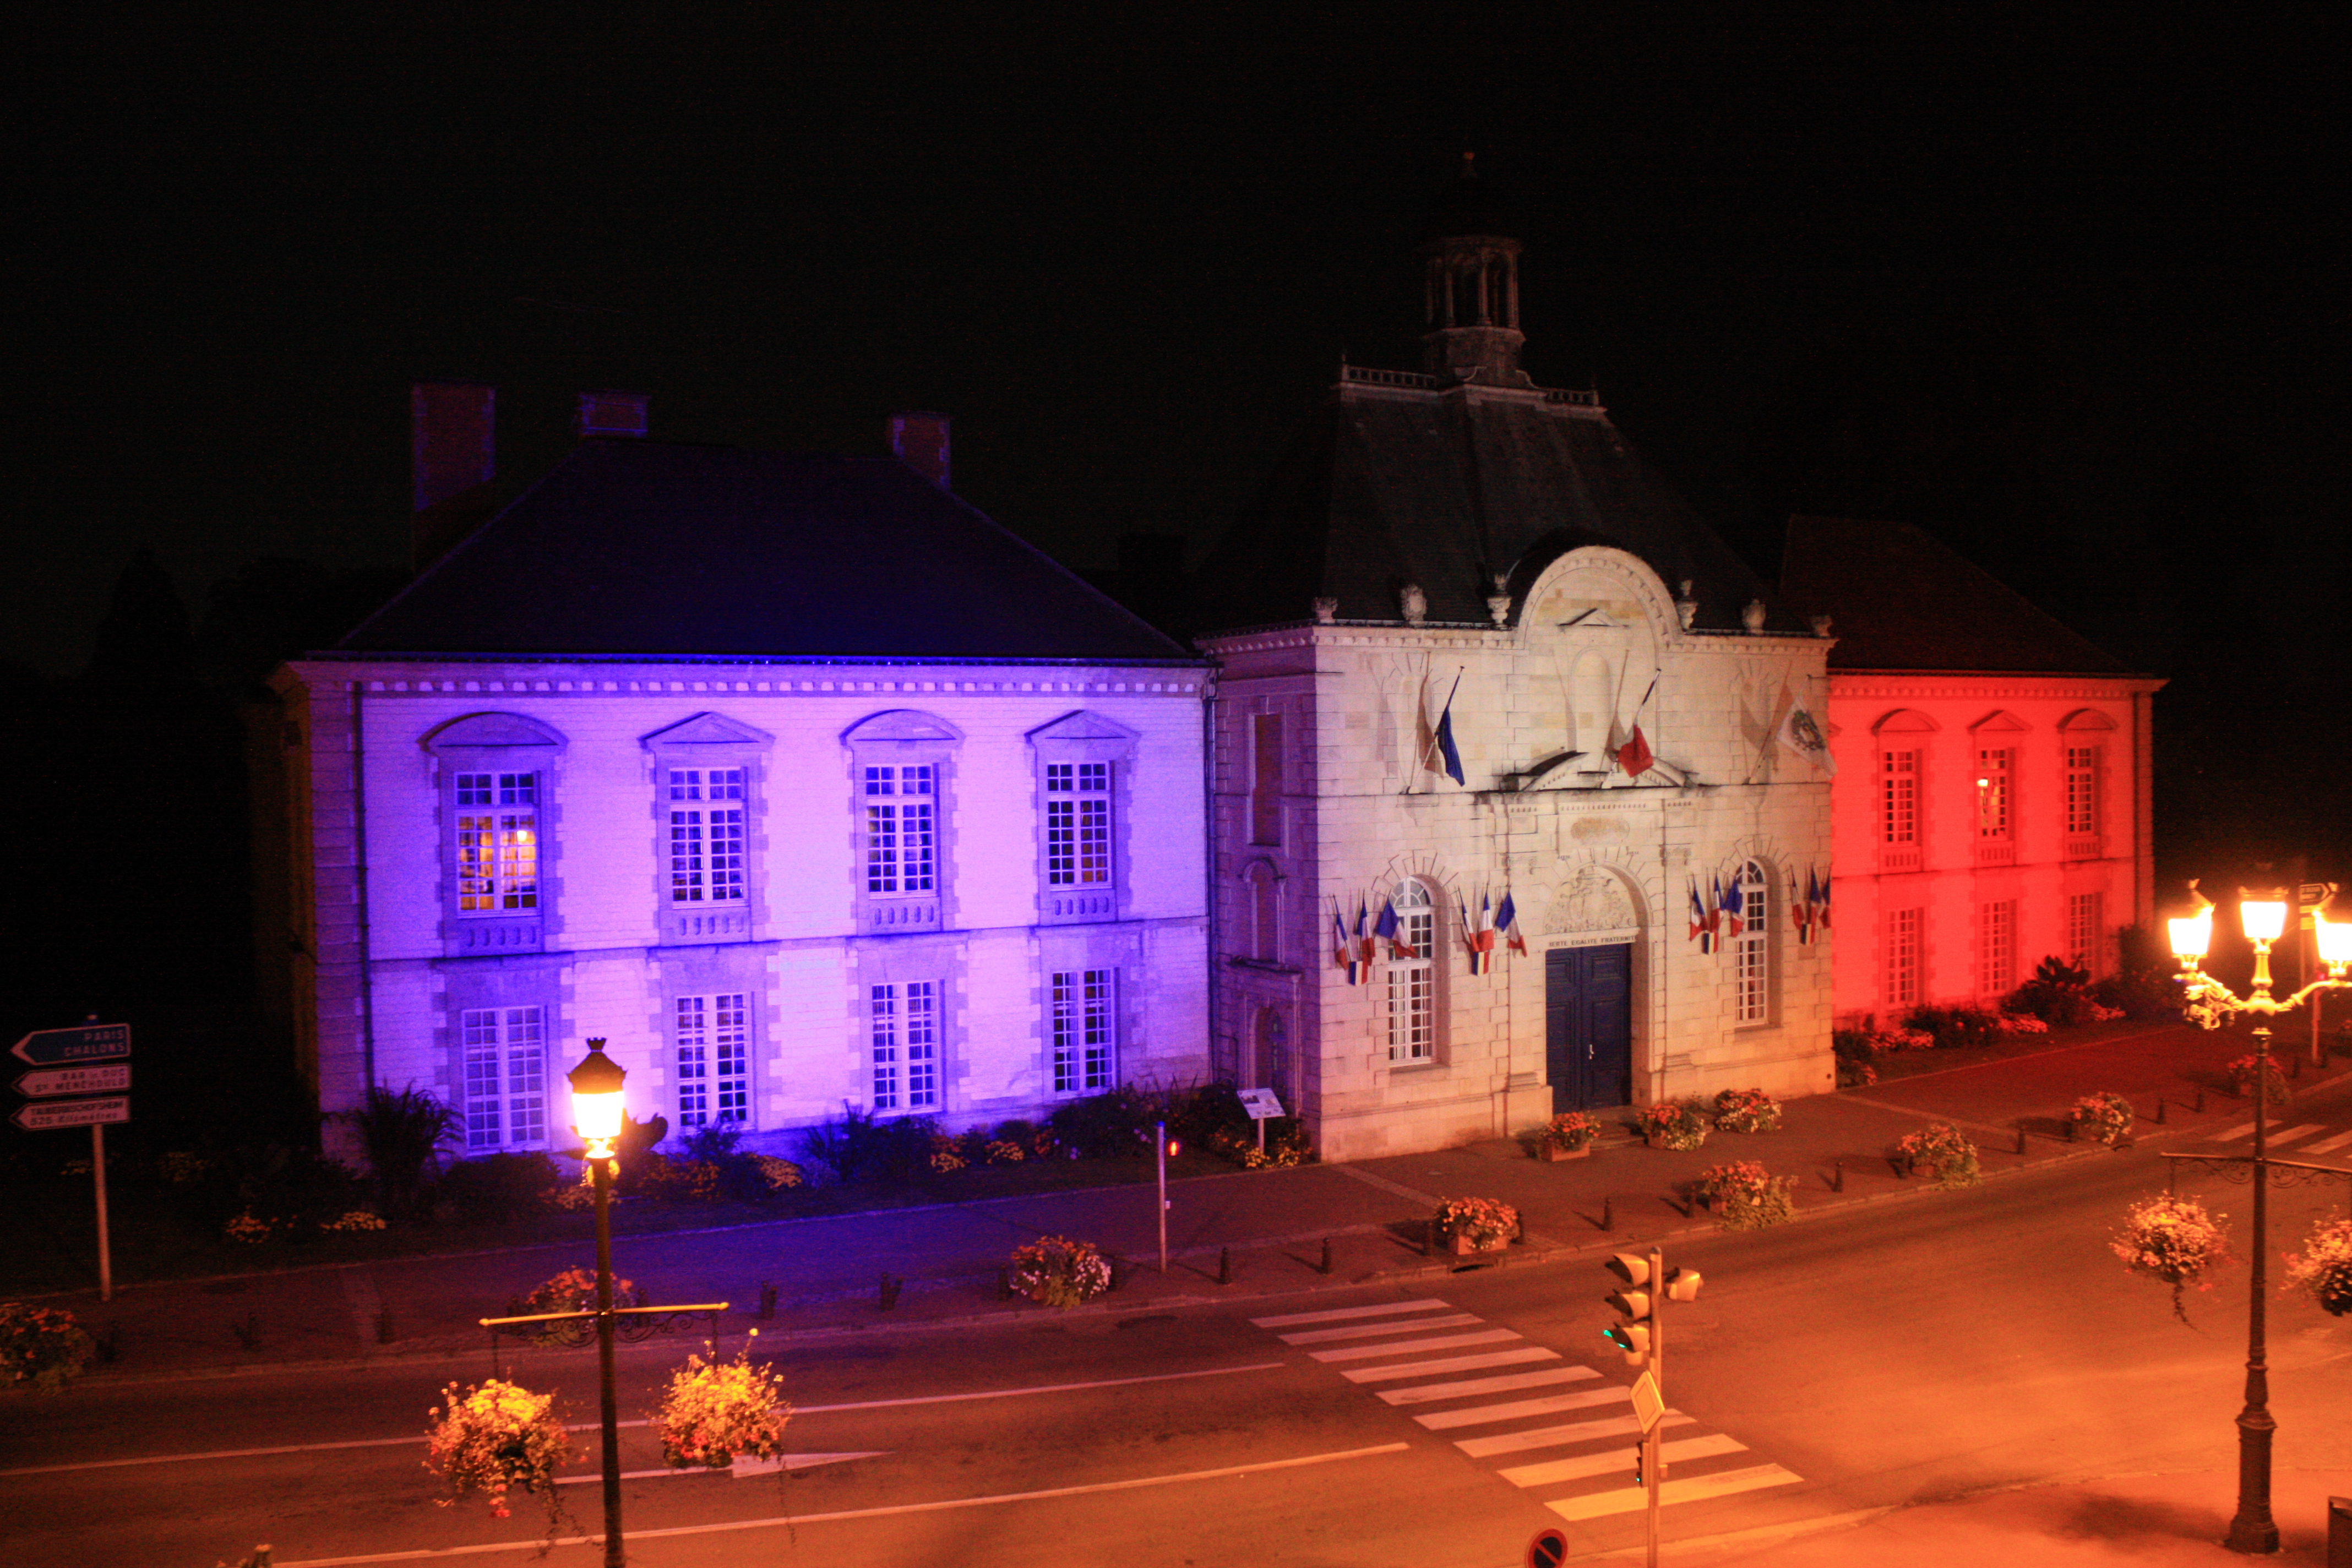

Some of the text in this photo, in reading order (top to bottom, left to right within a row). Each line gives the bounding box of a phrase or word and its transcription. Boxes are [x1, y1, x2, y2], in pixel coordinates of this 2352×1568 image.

[84, 1030, 124, 1040] PARIS
[64, 1043, 124, 1056] CHALONS
[62, 1071, 85, 1080] BAR
[102, 1068, 125, 1077] DUC
[55, 1078, 126, 1090] MENEHOULD
